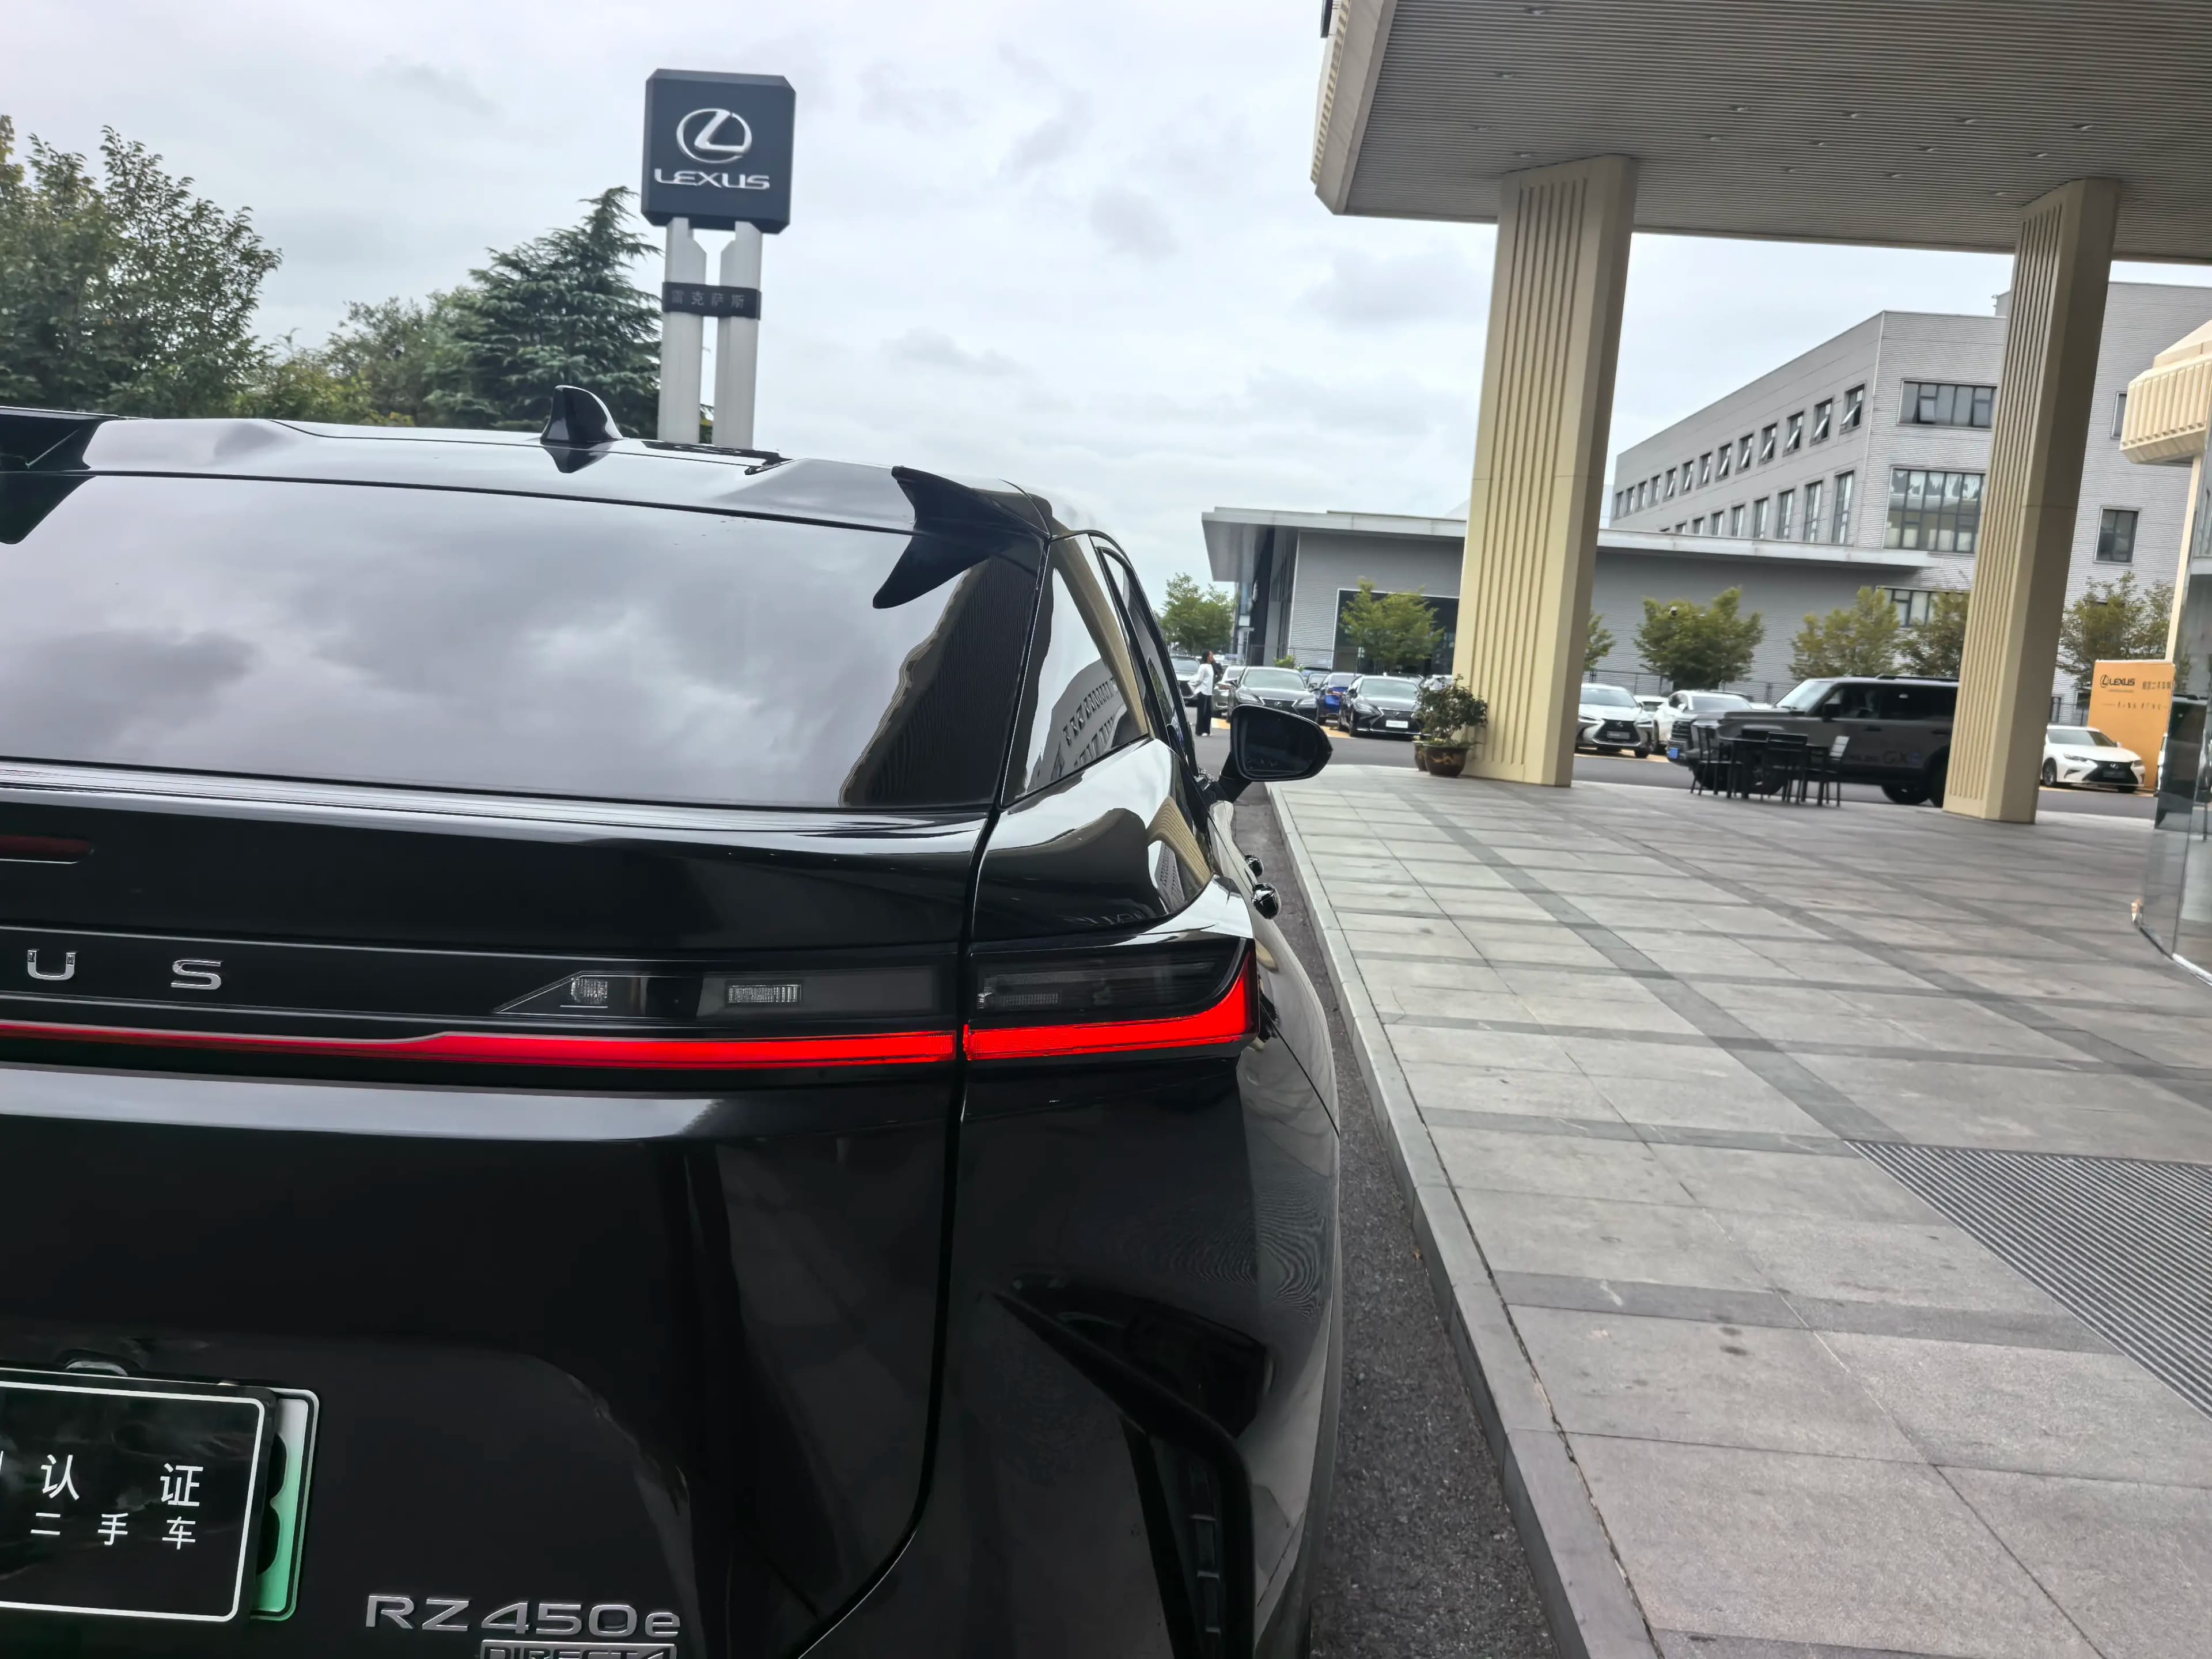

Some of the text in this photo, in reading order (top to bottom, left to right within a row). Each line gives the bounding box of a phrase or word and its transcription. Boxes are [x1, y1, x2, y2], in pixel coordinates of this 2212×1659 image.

[654, 168, 770, 190] LEXUS
[2109, 678, 2135, 686] LEXUS
[0, 1450, 204, 1508] 认证
[31, 1512, 196, 1550] 二手车
[365, 1594, 681, 1638] RZ 450e
